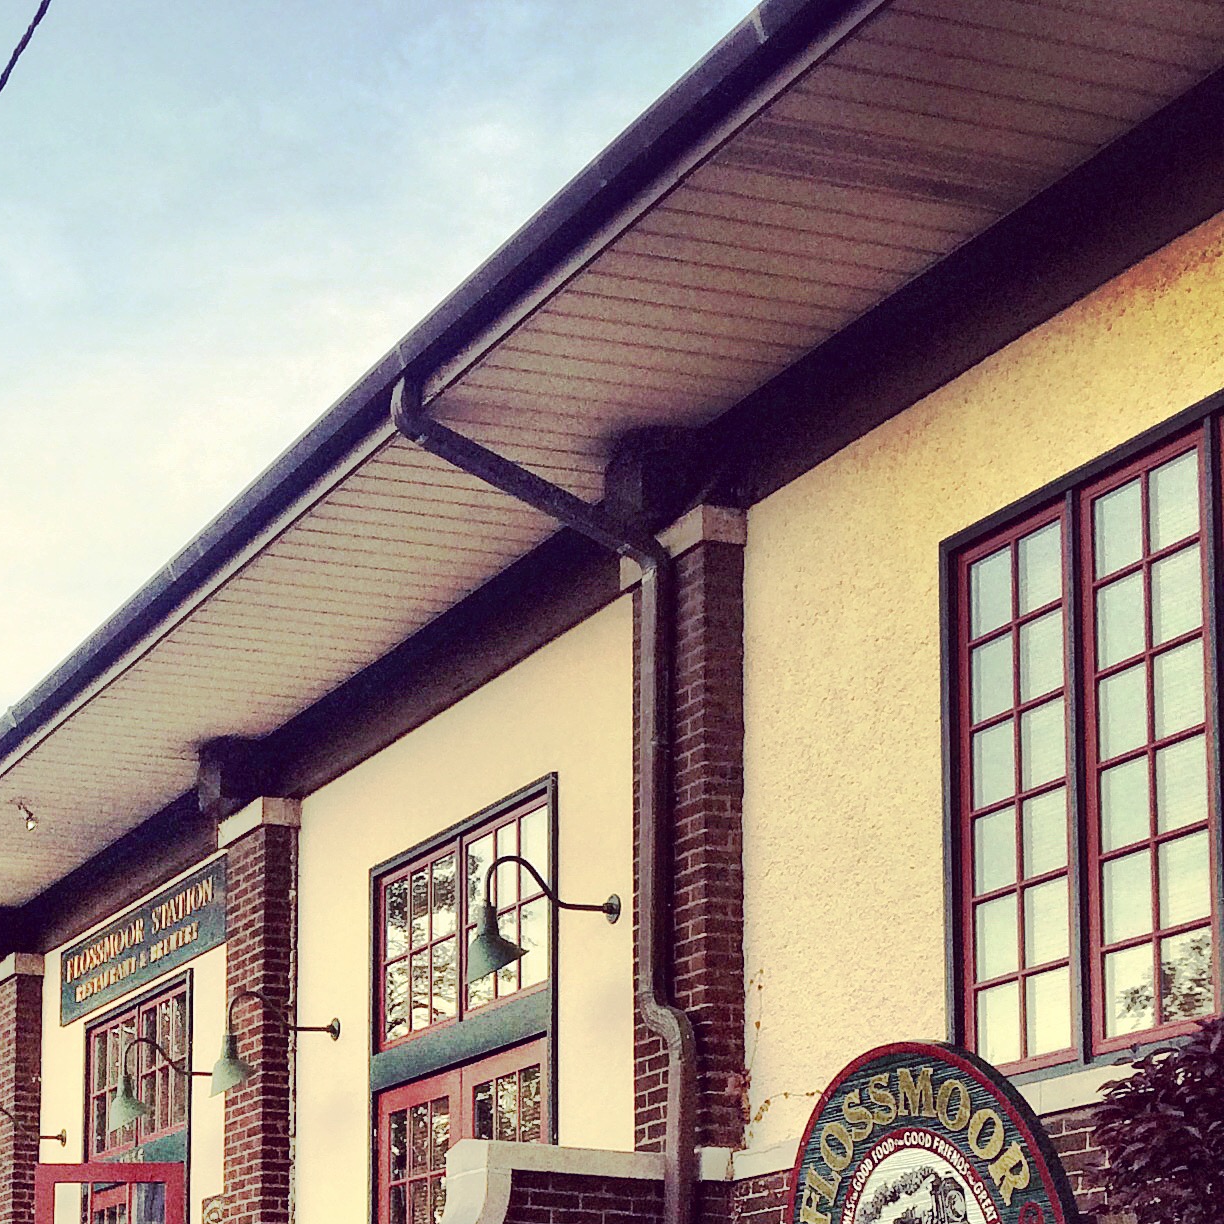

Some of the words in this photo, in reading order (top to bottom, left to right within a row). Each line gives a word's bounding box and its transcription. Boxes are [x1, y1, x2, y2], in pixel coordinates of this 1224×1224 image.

[151, 875, 213, 934] STATION
[852, 1159, 874, 1192] GOOD
[872, 1137, 895, 1164] FOOD
[903, 1131, 932, 1147] GOOD
[933, 1137, 970, 1176] FRIENDS
[973, 1181, 998, 1223] GREAT
